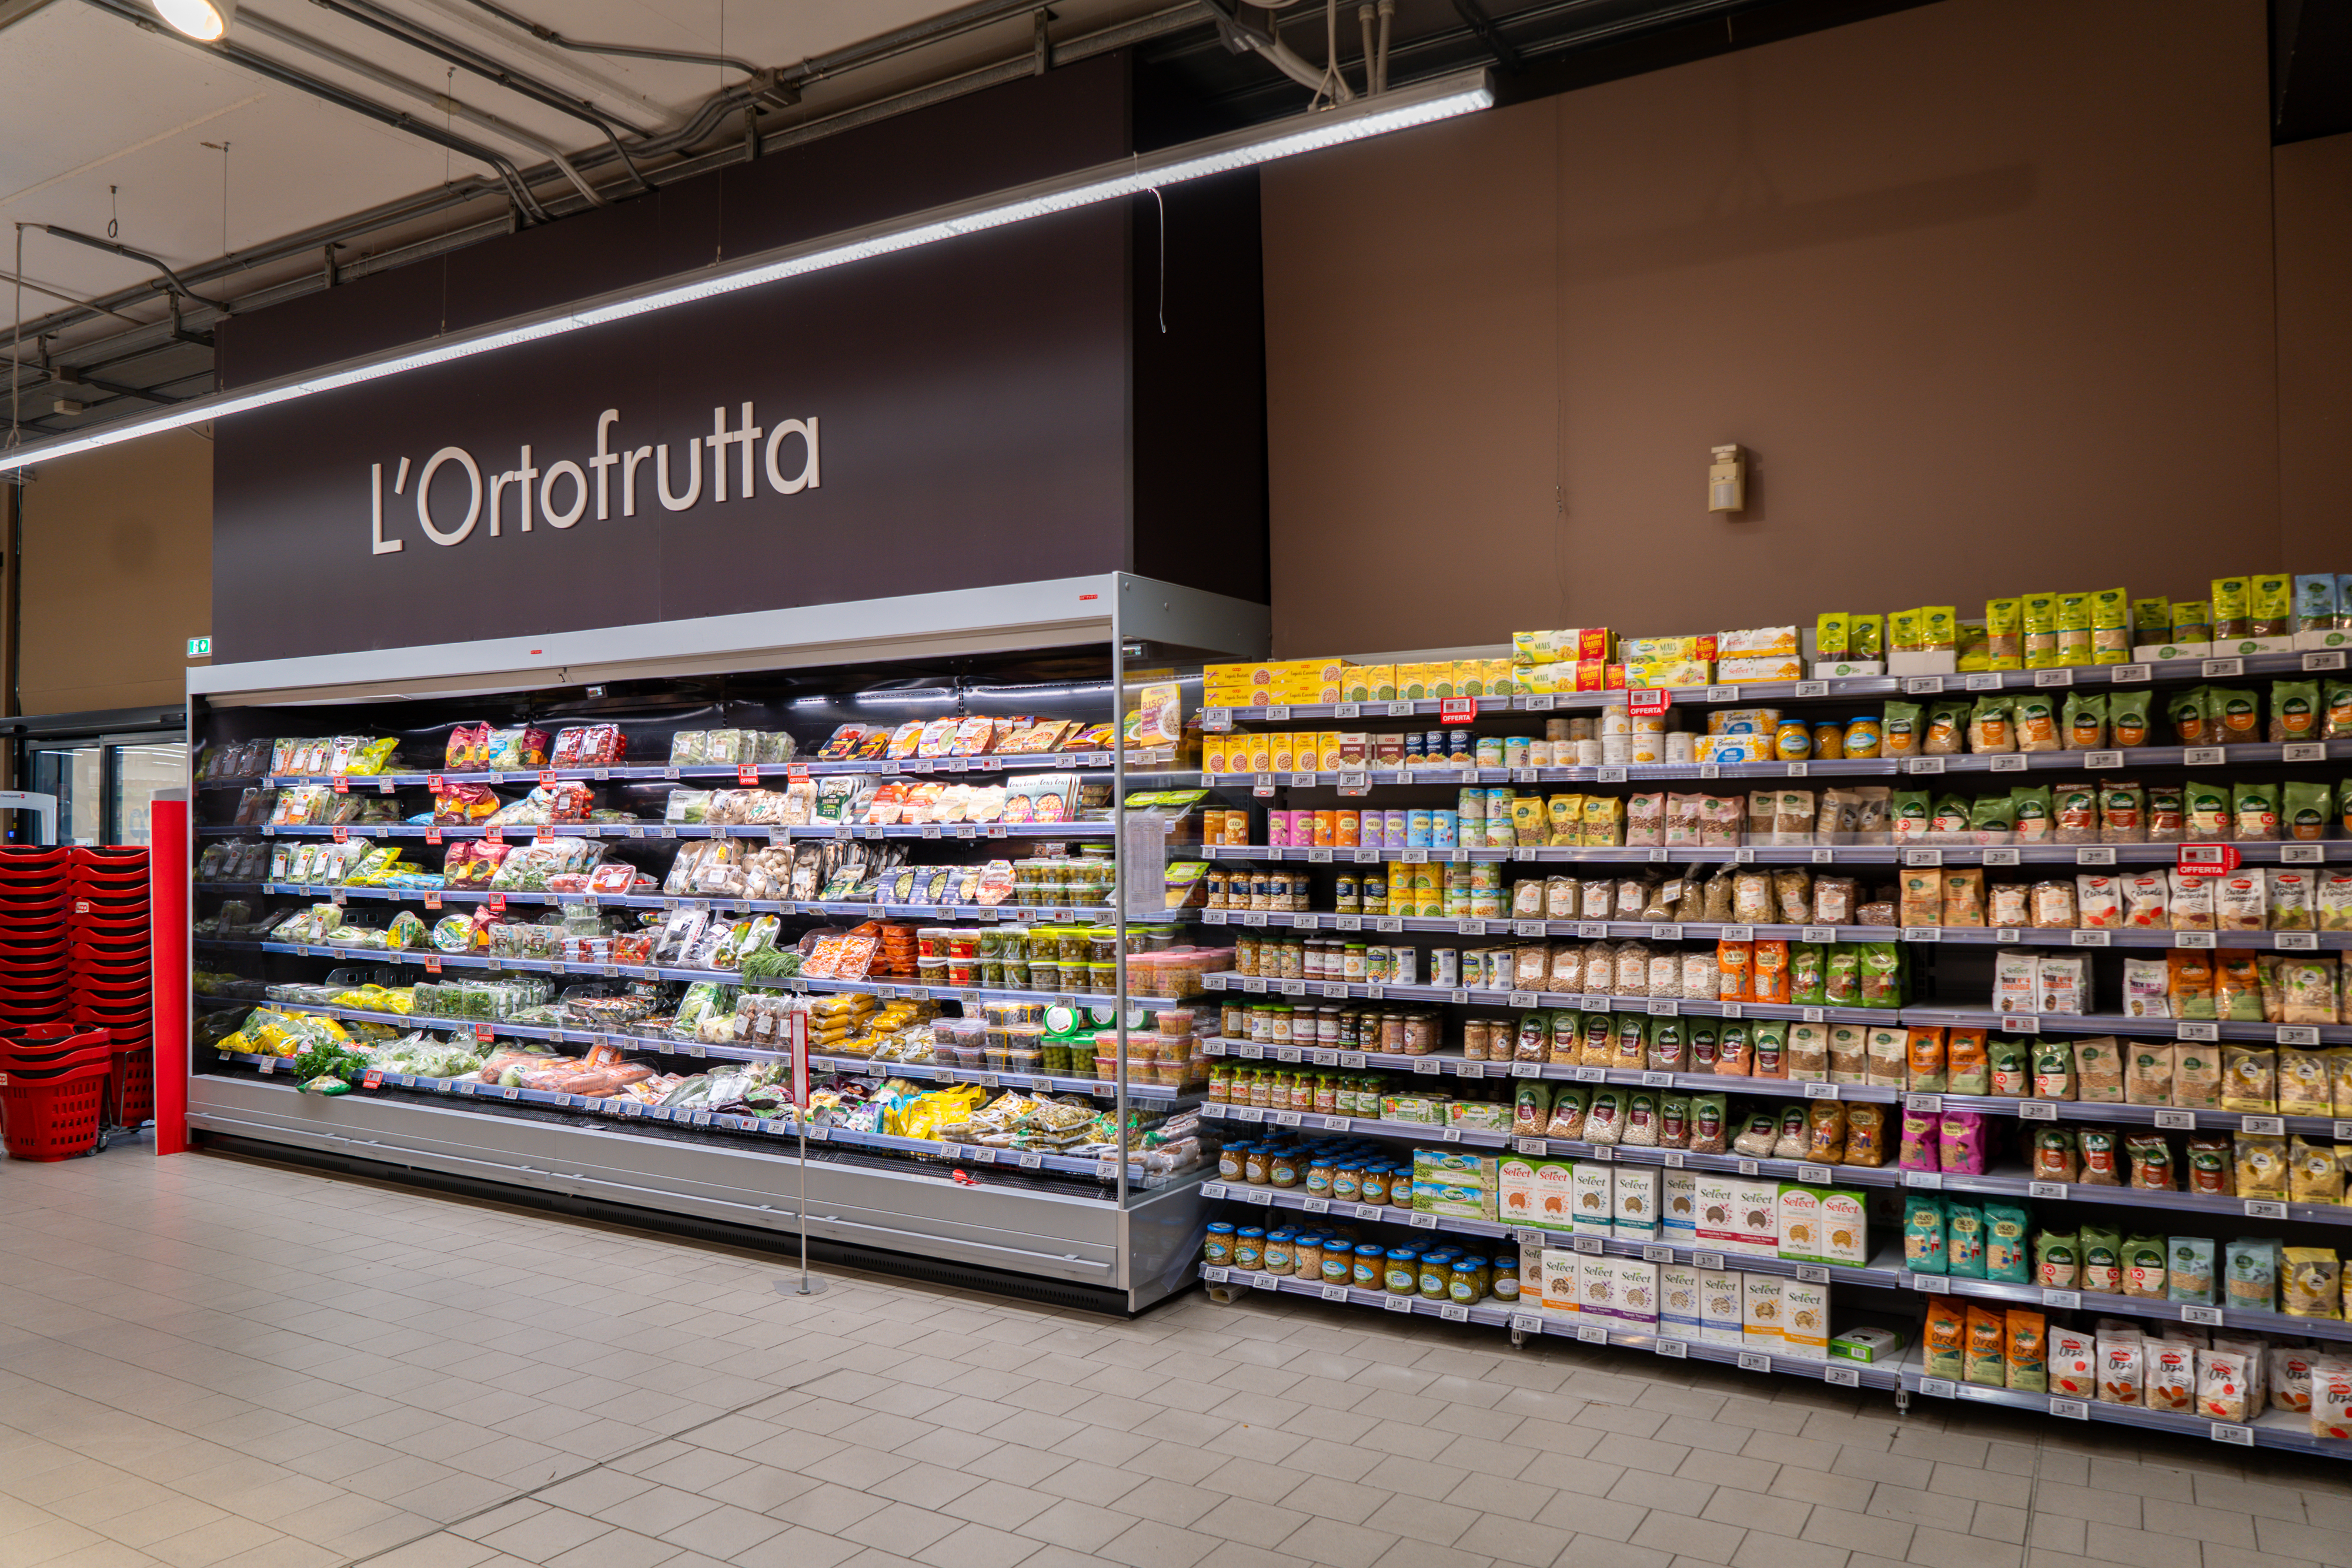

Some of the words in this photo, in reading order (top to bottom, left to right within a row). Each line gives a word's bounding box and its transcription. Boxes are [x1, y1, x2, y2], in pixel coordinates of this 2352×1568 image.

[372, 401, 820, 555] L'Ortofrutta
[1535, 642, 1550, 650] MAIS
[1581, 671, 1598, 680] GRATIS
[1608, 671, 1625, 679] GRATIS
[1504, 1168, 1530, 1178] Select
[1539, 1171, 1566, 1181] Select
[1577, 1175, 1605, 1186] Select
[1619, 1179, 1648, 1190] Select
[1699, 1189, 1731, 1199] Select
[1740, 1193, 1772, 1203] Select
[1783, 1196, 1815, 1208] Select
[1825, 1202, 1858, 1213] Select
[1545, 1262, 1575, 1272] Select
[1583, 1266, 1613, 1277] Select
[1621, 1271, 1651, 1283] Select
[1934, 1325, 1954, 1334] Gallo
[1932, 1333, 1956, 1345] Orzo
[1973, 1338, 1999, 1349] Orzo
[2013, 1345, 2039, 1356] Orzo
